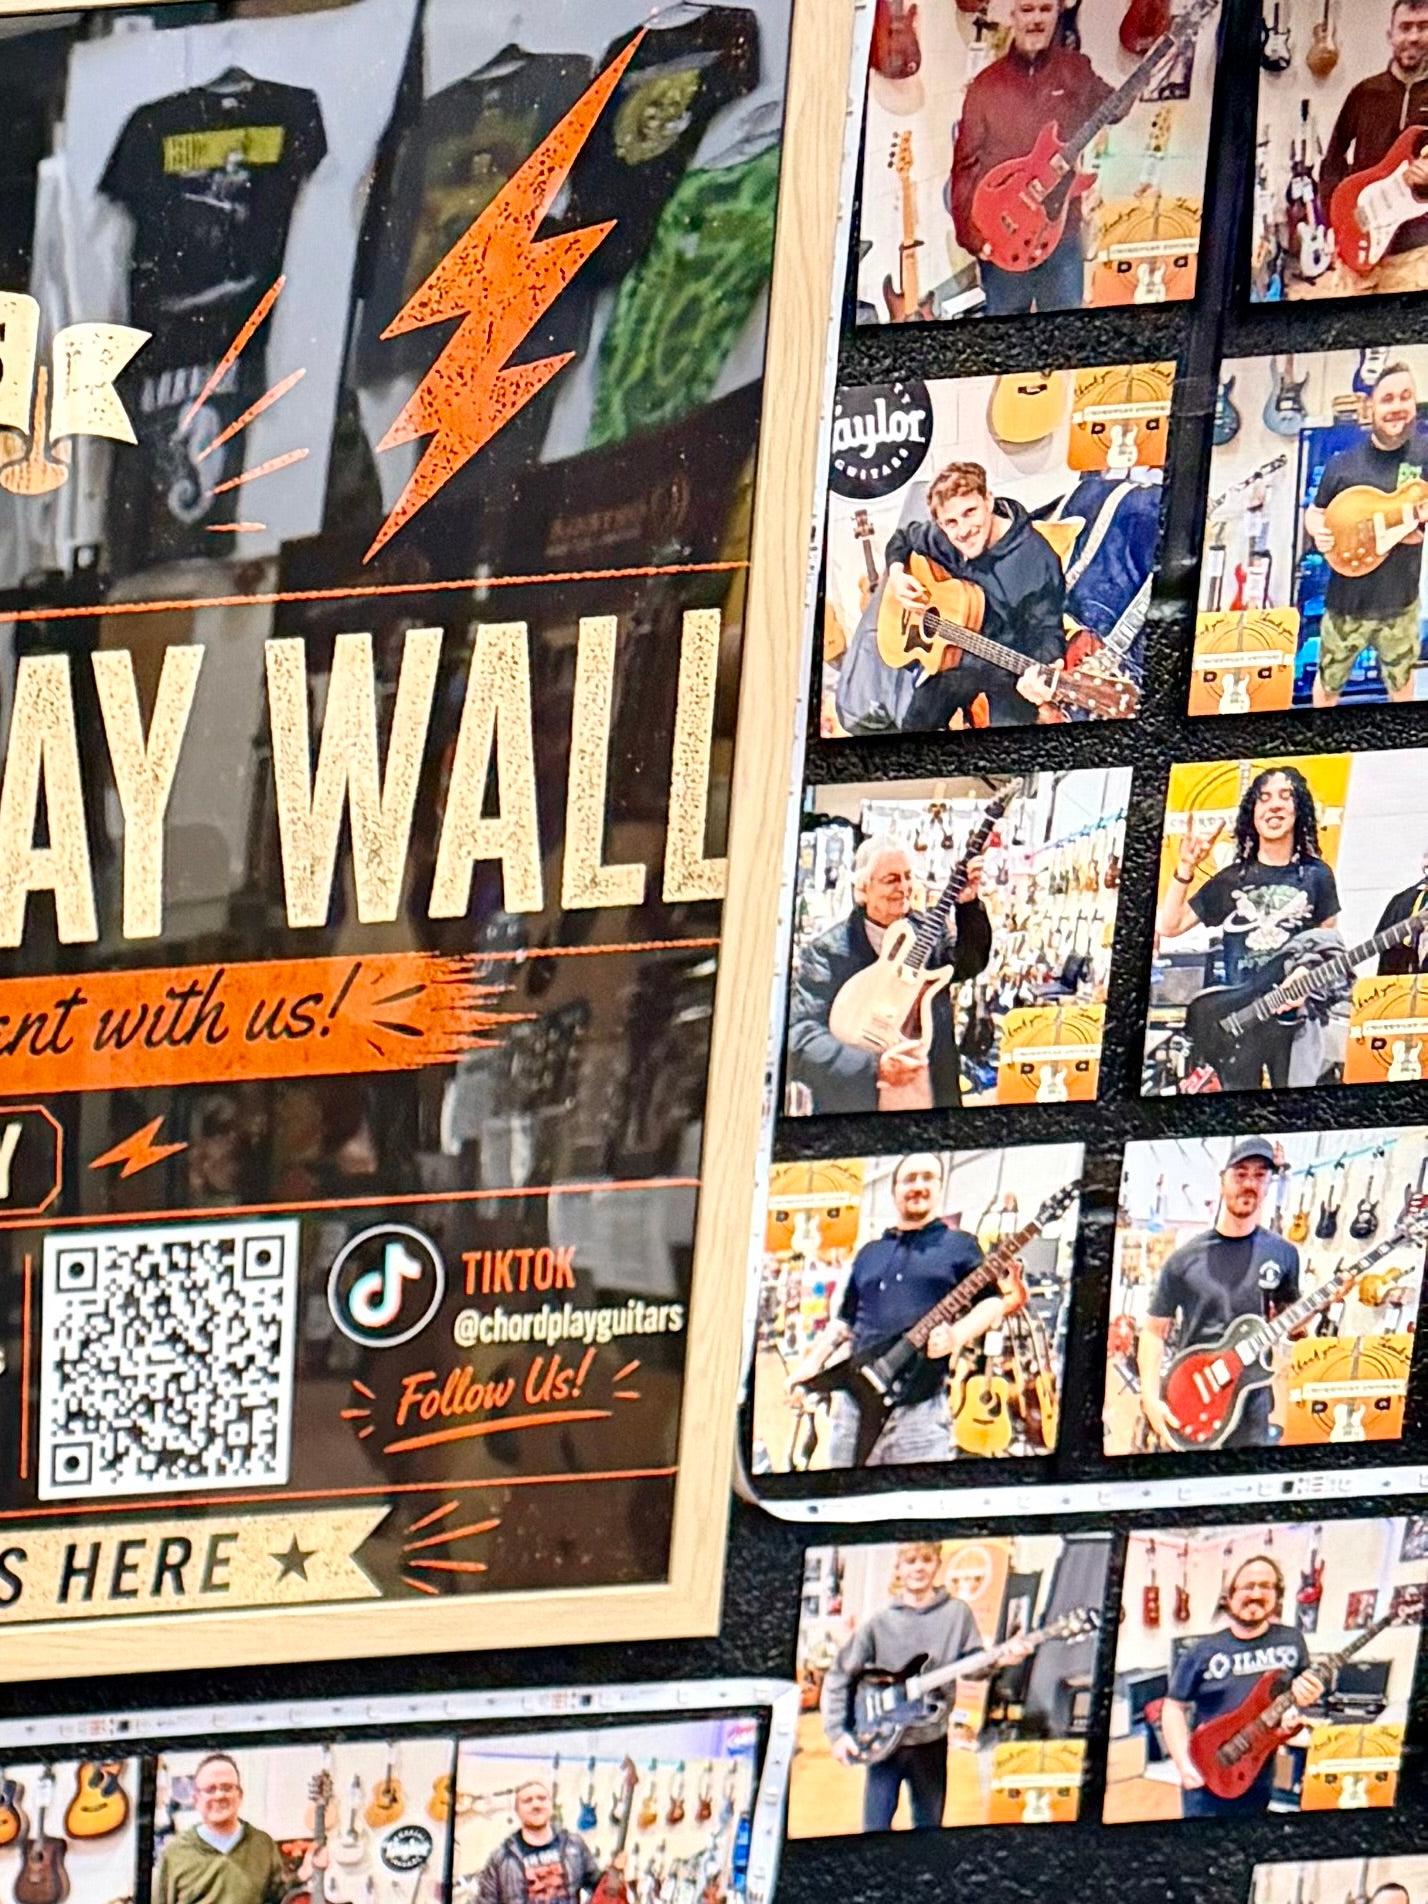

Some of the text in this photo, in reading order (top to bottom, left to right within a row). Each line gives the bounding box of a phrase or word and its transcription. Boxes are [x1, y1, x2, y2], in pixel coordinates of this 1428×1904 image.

[264, 608, 728, 930] WALL
[93, 970, 231, 1050] with
[245, 961, 363, 1039] us!
[461, 1246, 576, 1296] TIKTOK
[453, 1299, 684, 1348] @chordplayguitars
[396, 1346, 597, 1427] Follow Us!
[58, 1532, 239, 1602] HERE
